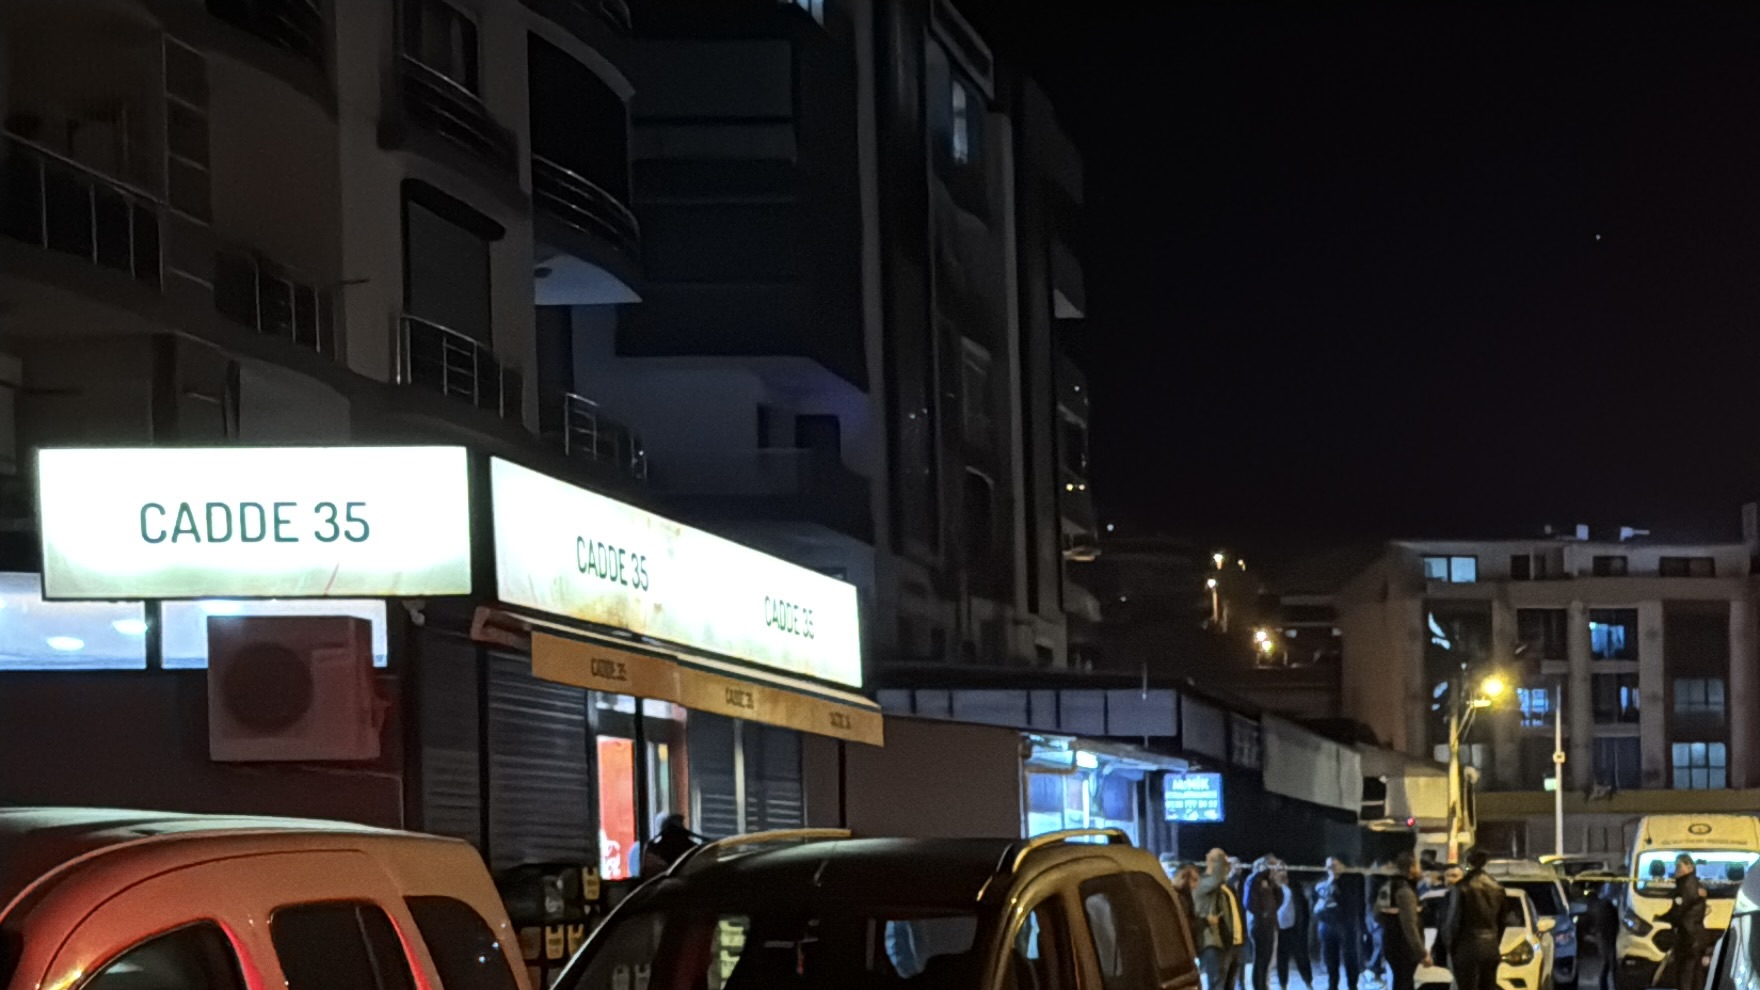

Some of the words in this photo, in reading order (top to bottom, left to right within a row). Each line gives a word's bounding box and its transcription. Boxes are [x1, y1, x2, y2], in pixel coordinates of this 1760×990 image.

[140, 501, 299, 544] CADDE
[314, 501, 370, 543] 35
[576, 536, 628, 587] CADDE
[631, 552, 649, 592] 35
[764, 596, 801, 636] CADDE
[802, 607, 815, 640] 35
